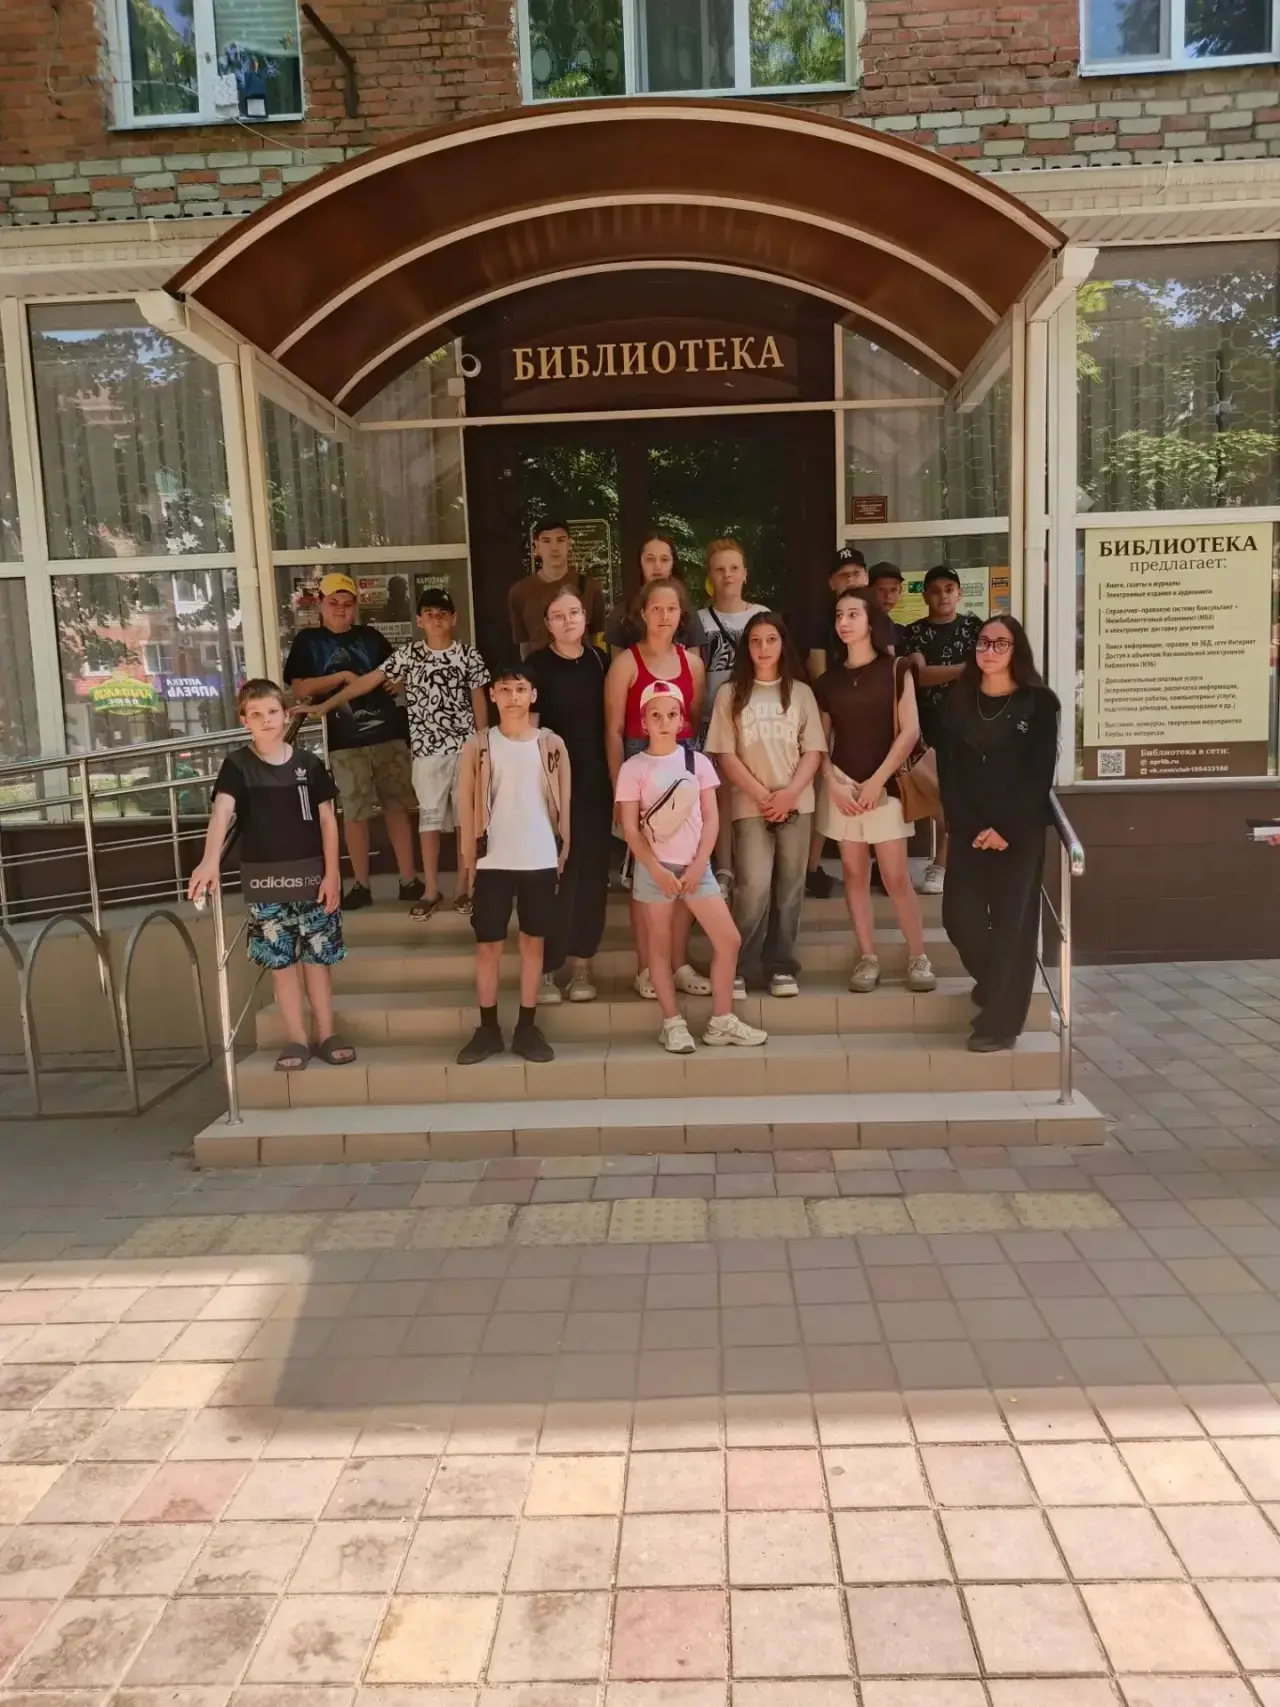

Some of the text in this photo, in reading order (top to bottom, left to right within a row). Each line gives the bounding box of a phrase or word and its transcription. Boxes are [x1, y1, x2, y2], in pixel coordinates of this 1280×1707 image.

[512, 335, 785, 380] БИБЛИОТЕКА
[1099, 535, 1258, 557] БИБЛИОТЕКА
[1129, 557, 1228, 574] предлагает:
[1153, 580, 1181, 588] журналы
[1196, 604, 1233, 612] Консультант
[1151, 625, 1178, 633] доставку
[1179, 624, 1215, 632] документов
[1131, 651, 1161, 659] объектам
[1140, 748, 1196, 757] Библиотека
[1205, 747, 1230, 755] сети:
[250, 874, 321, 889] adidas neo
